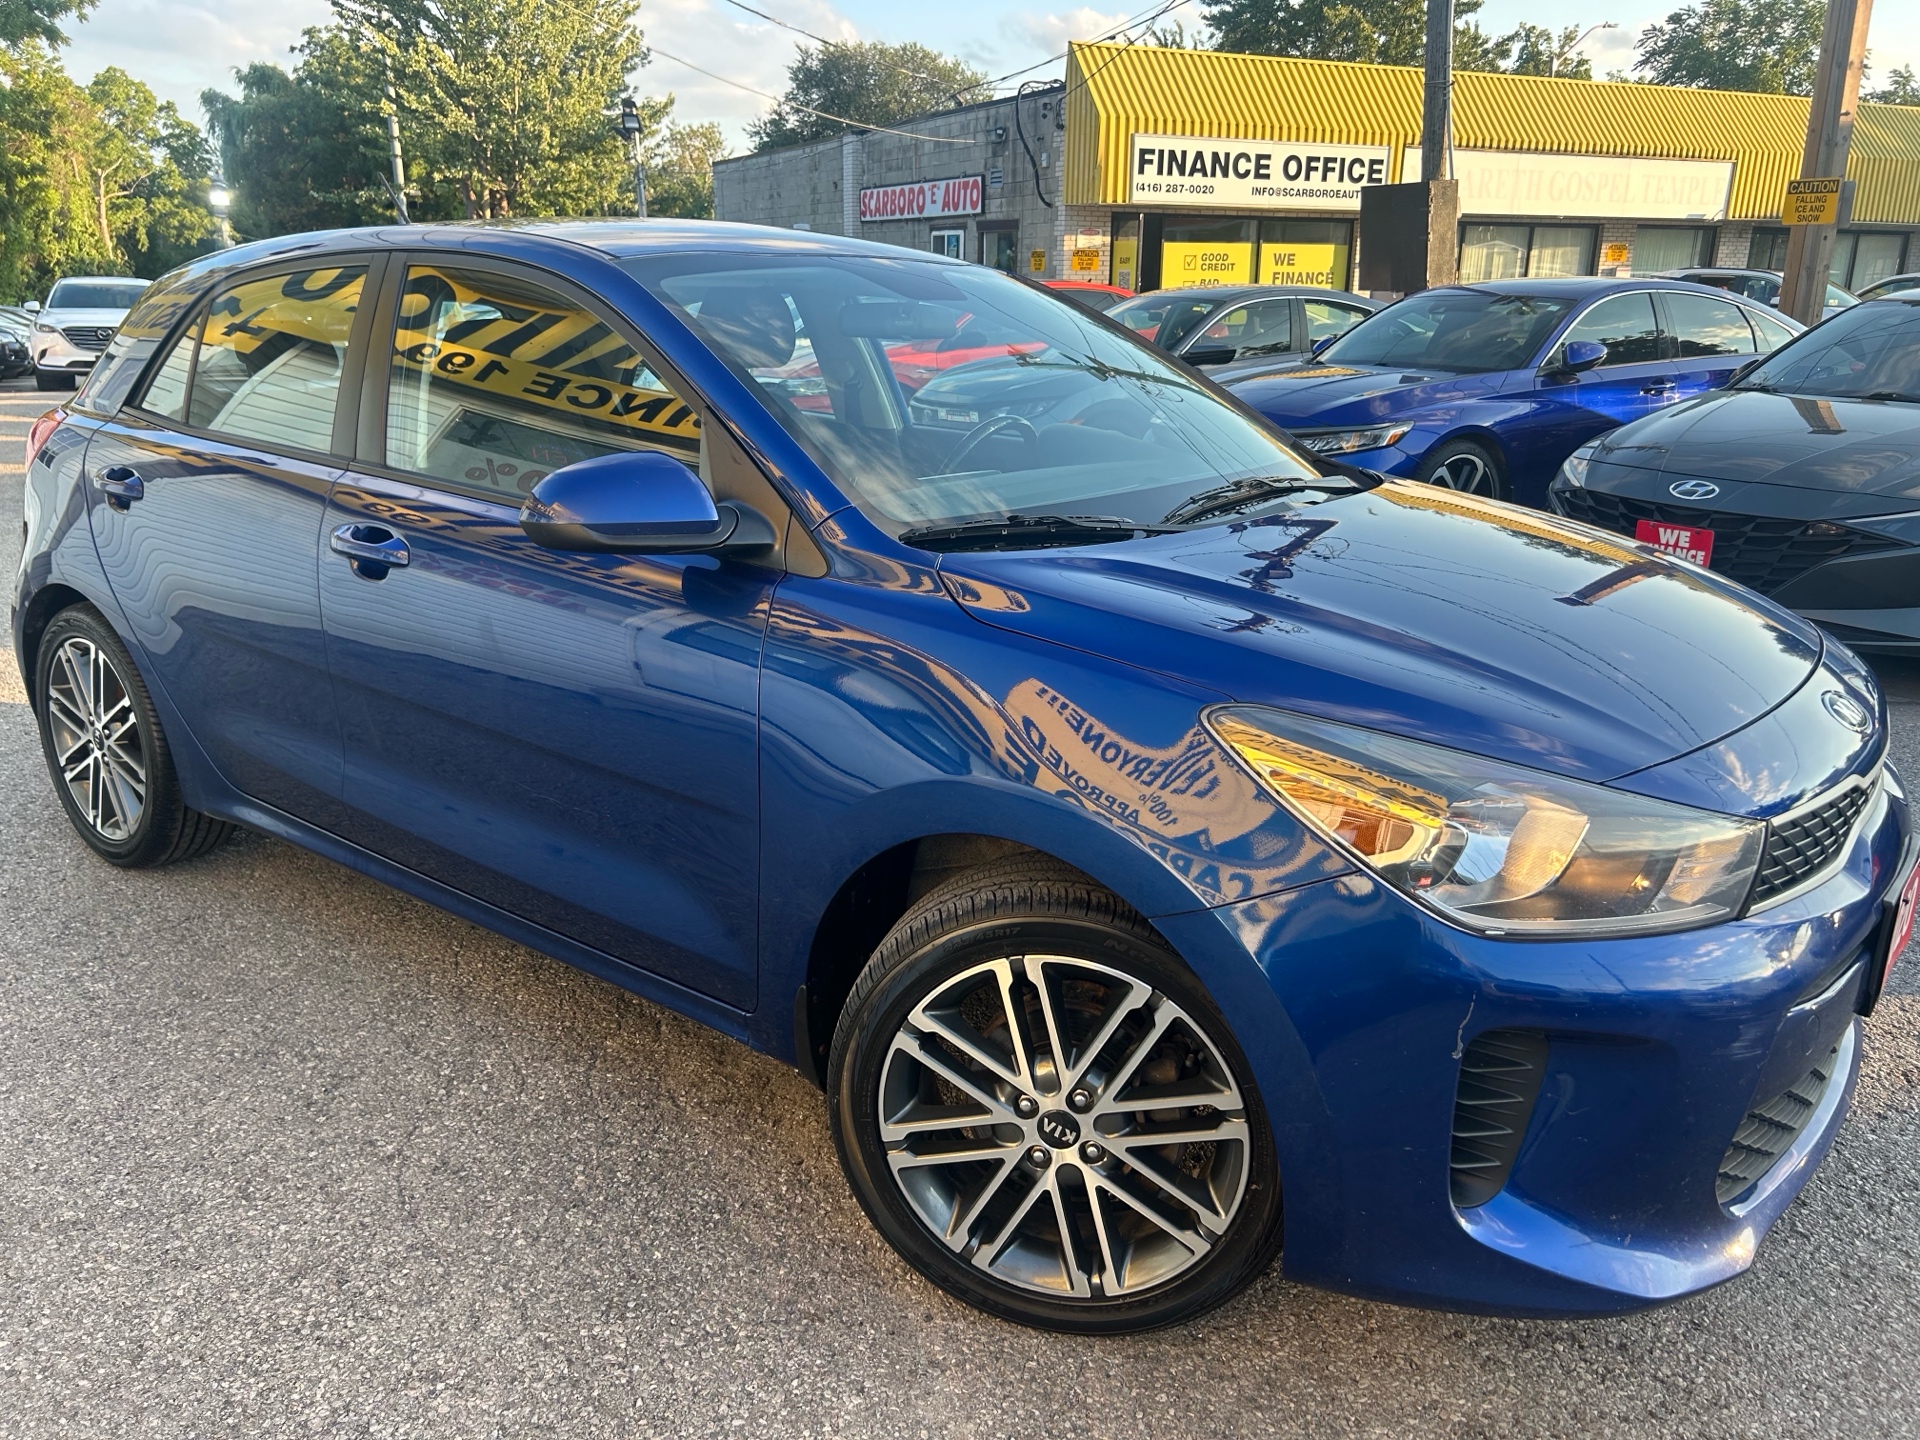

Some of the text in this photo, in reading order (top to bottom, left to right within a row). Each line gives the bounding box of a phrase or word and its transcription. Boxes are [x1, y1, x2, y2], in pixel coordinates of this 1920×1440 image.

[1137, 148, 1384, 184] FINANCE OFFICE
[1135, 183, 1162, 194] (416)
[1165, 184, 1215, 195] 287-0020
[1548, 169, 1636, 204] GOSPEL
[1641, 174, 1726, 206] TEMPLE
[1790, 180, 1838, 194] CAUTION
[861, 185, 926, 219] SCARBORO
[941, 179, 981, 212] AUTO
[1795, 195, 1828, 204] FALLING
[1795, 204, 1826, 213] ICE AND
[1796, 214, 1821, 223] SNOW
[1073, 250, 1099, 258] CAUTION
[1200, 253, 1229, 262] GOOD
[1273, 252, 1296, 267] WE
[1119, 257, 1131, 265] EASY
[1200, 263, 1236, 272] CREDIT
[1271, 271, 1334, 285] FINANCE
[1658, 527, 1691, 548] WE
[1043, 1116, 1077, 1145] KIA
